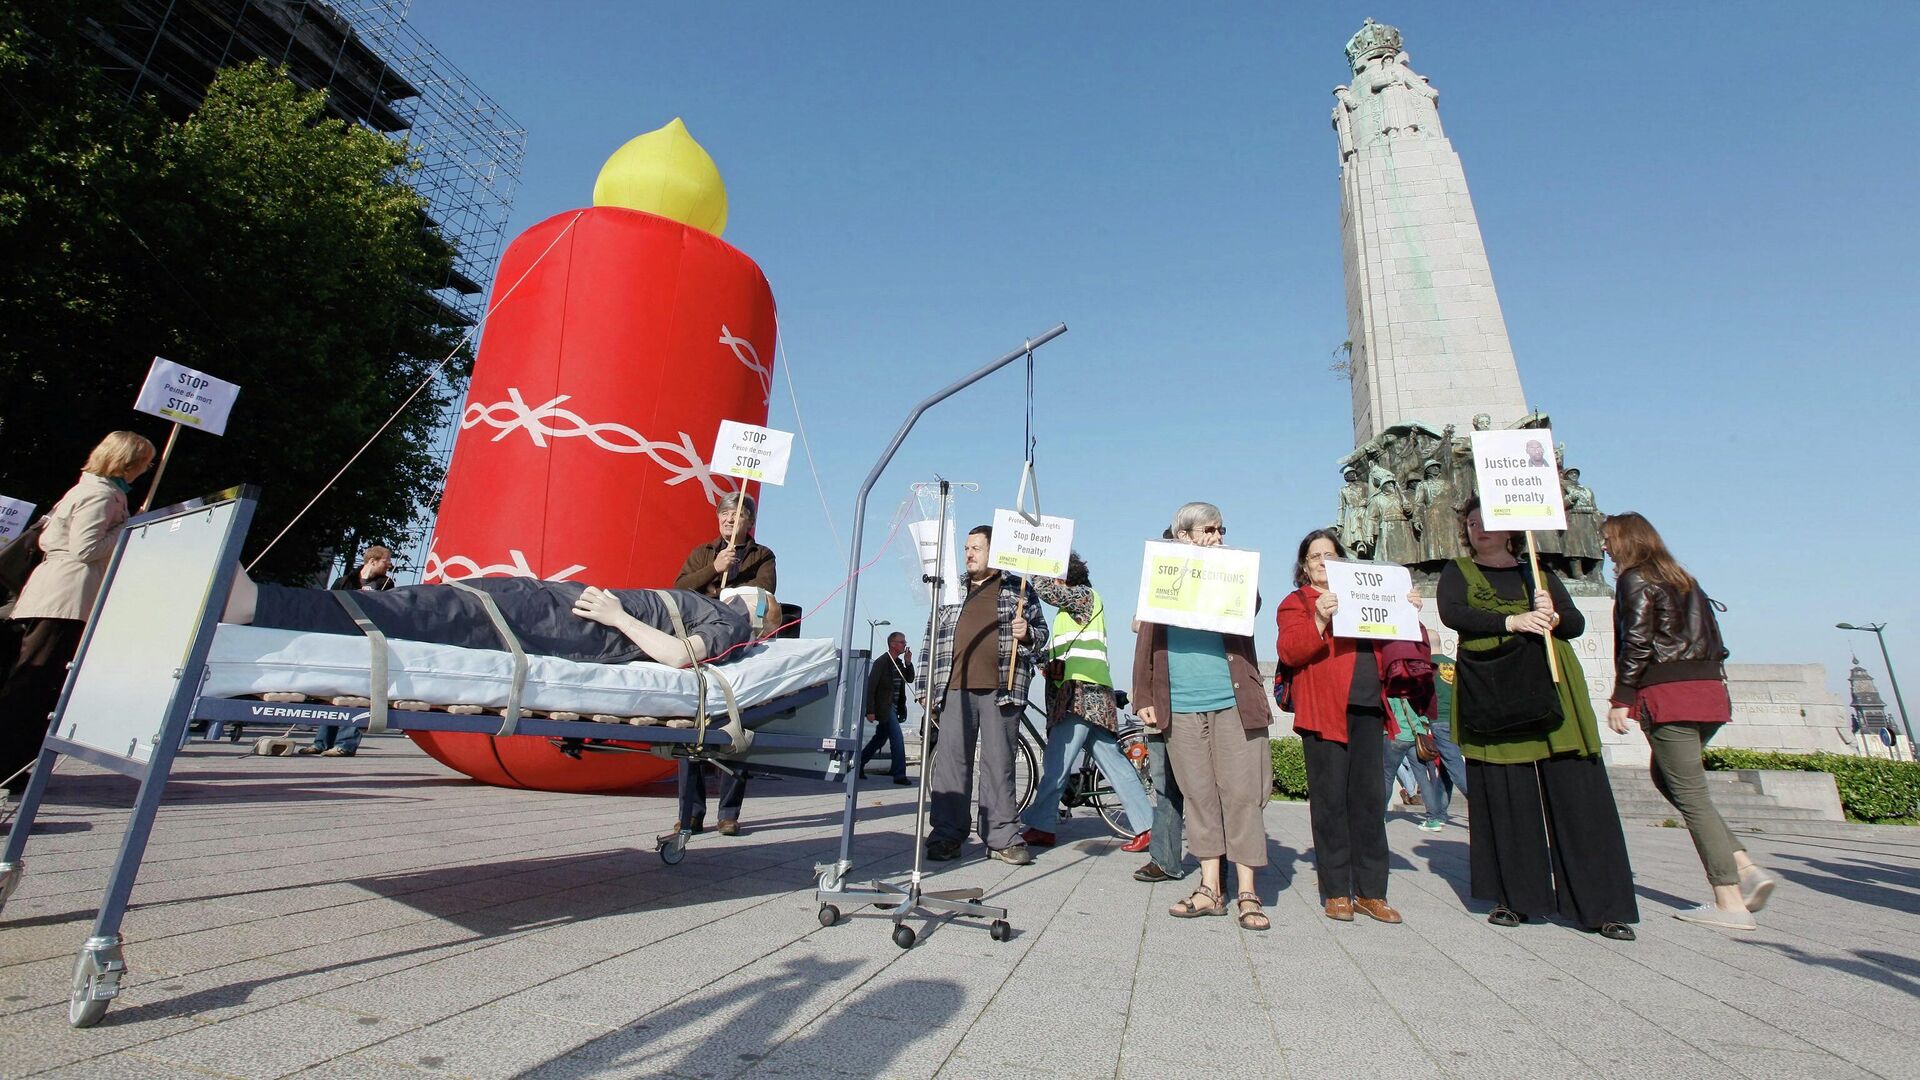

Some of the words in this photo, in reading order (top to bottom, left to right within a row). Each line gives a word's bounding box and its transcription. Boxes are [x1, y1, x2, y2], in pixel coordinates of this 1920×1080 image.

[178, 373, 209, 390] STOP
[164, 383, 185, 396] Peine
[185, 390, 195, 399] de
[196, 394, 213, 405] mort
[167, 397, 199, 415] STOP
[742, 430, 768, 444] STOP
[731, 443, 748, 453] Peine
[748, 446, 757, 454] de
[757, 448, 772, 457] mort
[735, 455, 761, 469] STOP
[1485, 456, 1527, 469] Justice
[1495, 478, 1508, 487] no
[1511, 475, 1542, 487] death
[1504, 491, 1545, 504] penalty
[0, 504, 18, 516] TOP
[1013, 530, 1029, 541] Stop
[1030, 532, 1052, 543] Death
[1017, 544, 1047, 557] Penalty!
[1158, 565, 1179, 576] STOP
[1354, 571, 1384, 587] STOP
[1155, 588, 1180, 597] AMNESTY
[1350, 590, 1371, 601] Peine
[1371, 592, 1380, 602] de
[1381, 594, 1397, 603] mort
[1361, 606, 1389, 623] STOP
[251, 705, 350, 721] VERMEIREN
